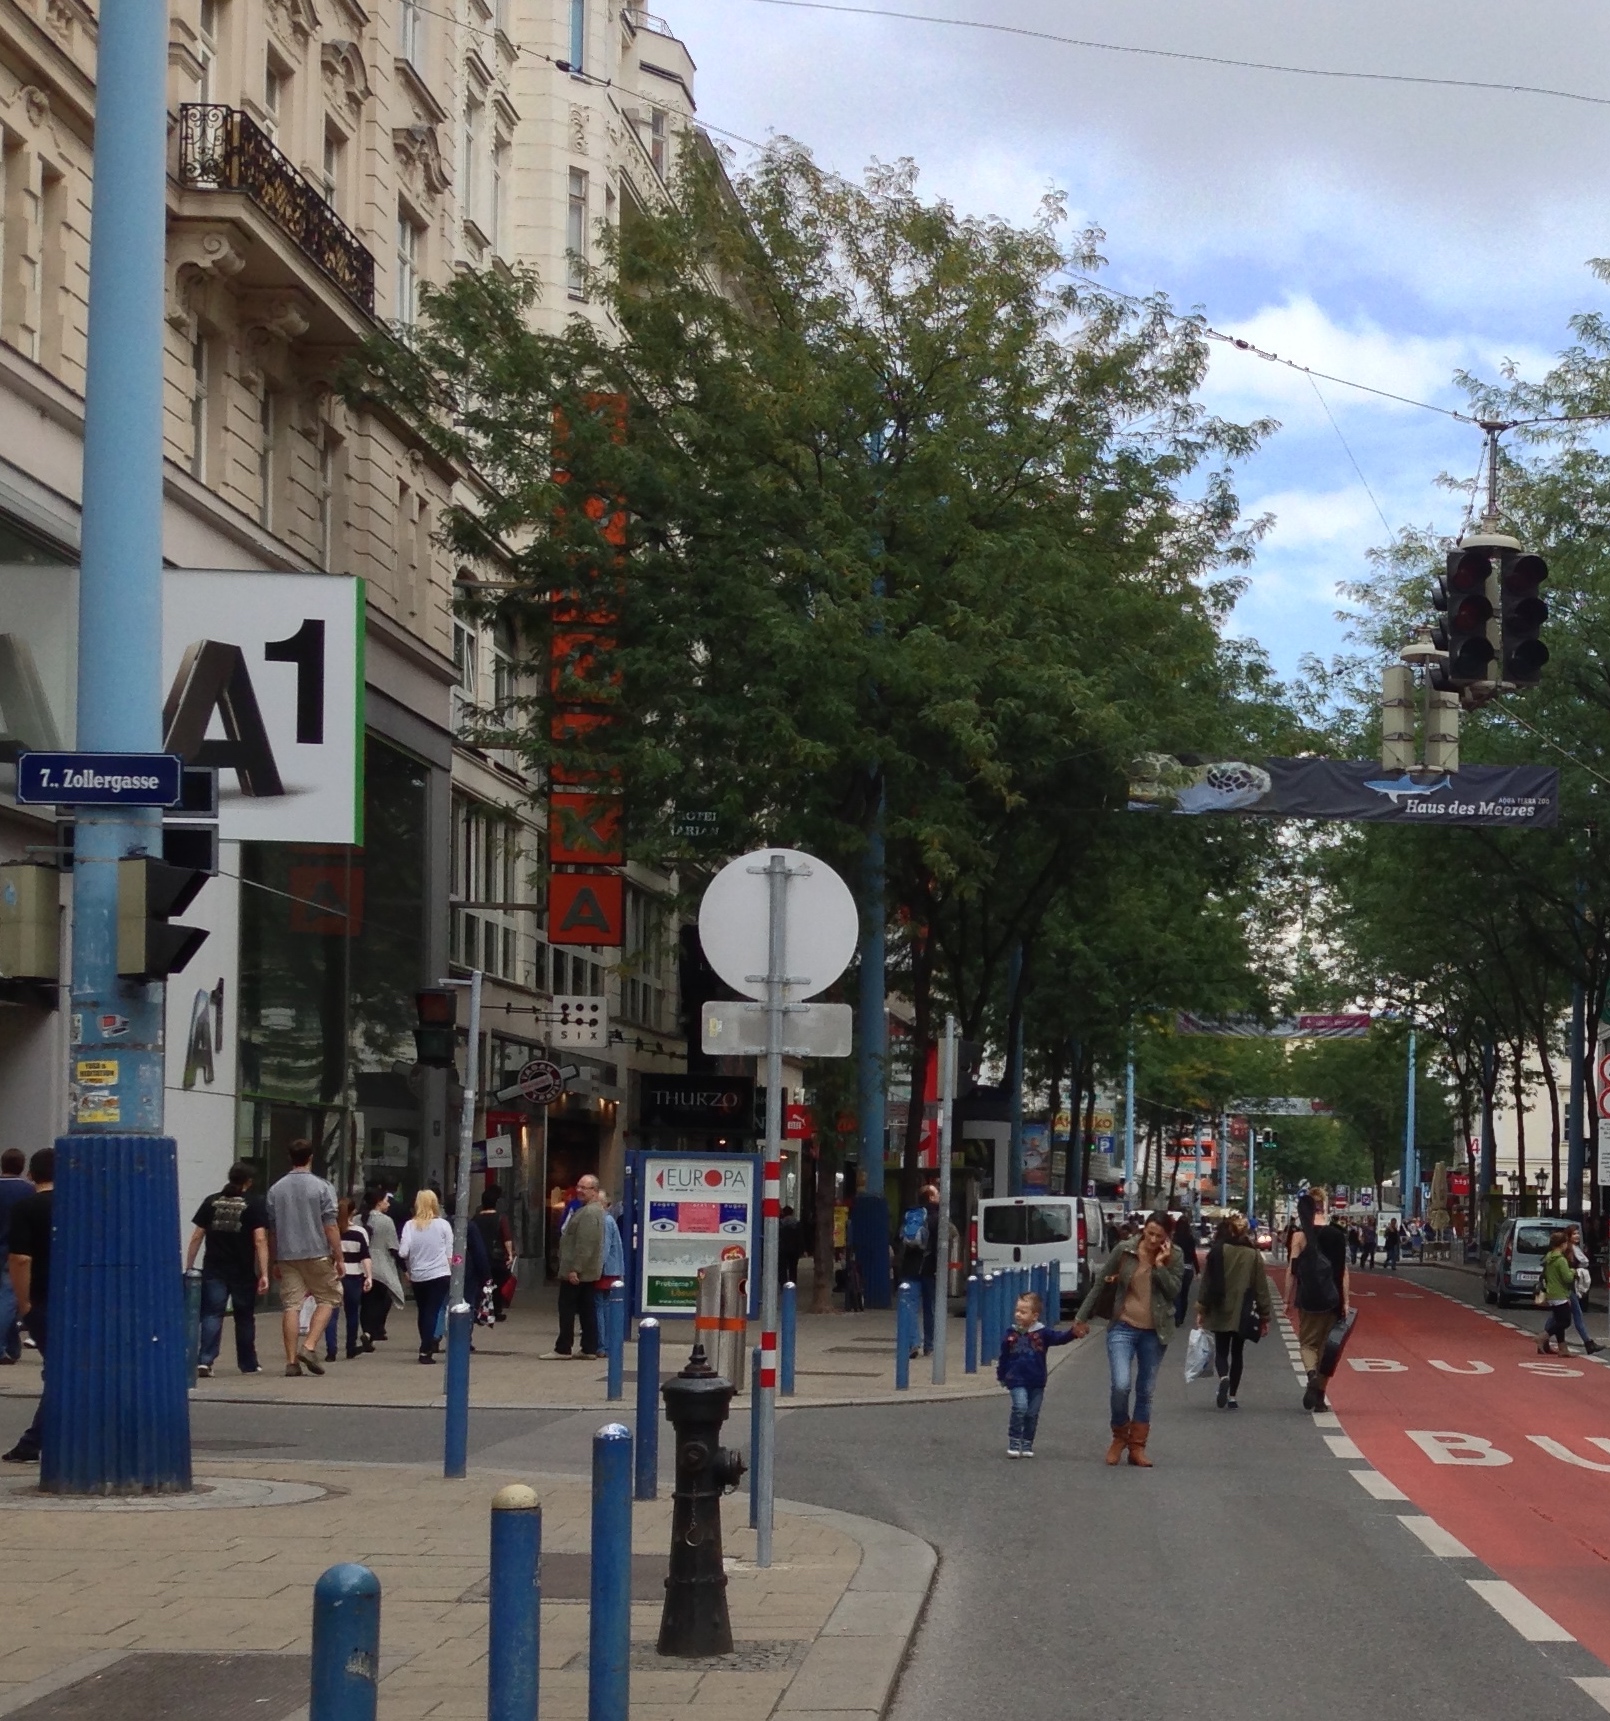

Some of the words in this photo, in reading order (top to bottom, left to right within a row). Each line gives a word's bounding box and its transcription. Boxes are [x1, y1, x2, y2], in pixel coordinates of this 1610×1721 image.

[63, 769, 159, 793] Zollergasse
[1405, 799, 1446, 814] Haus
[1448, 801, 1476, 815] des
[1478, 802, 1536, 817] Meeres
[560, 1031, 598, 1041] SIX
[1347, 1358, 1585, 1378] BUS
